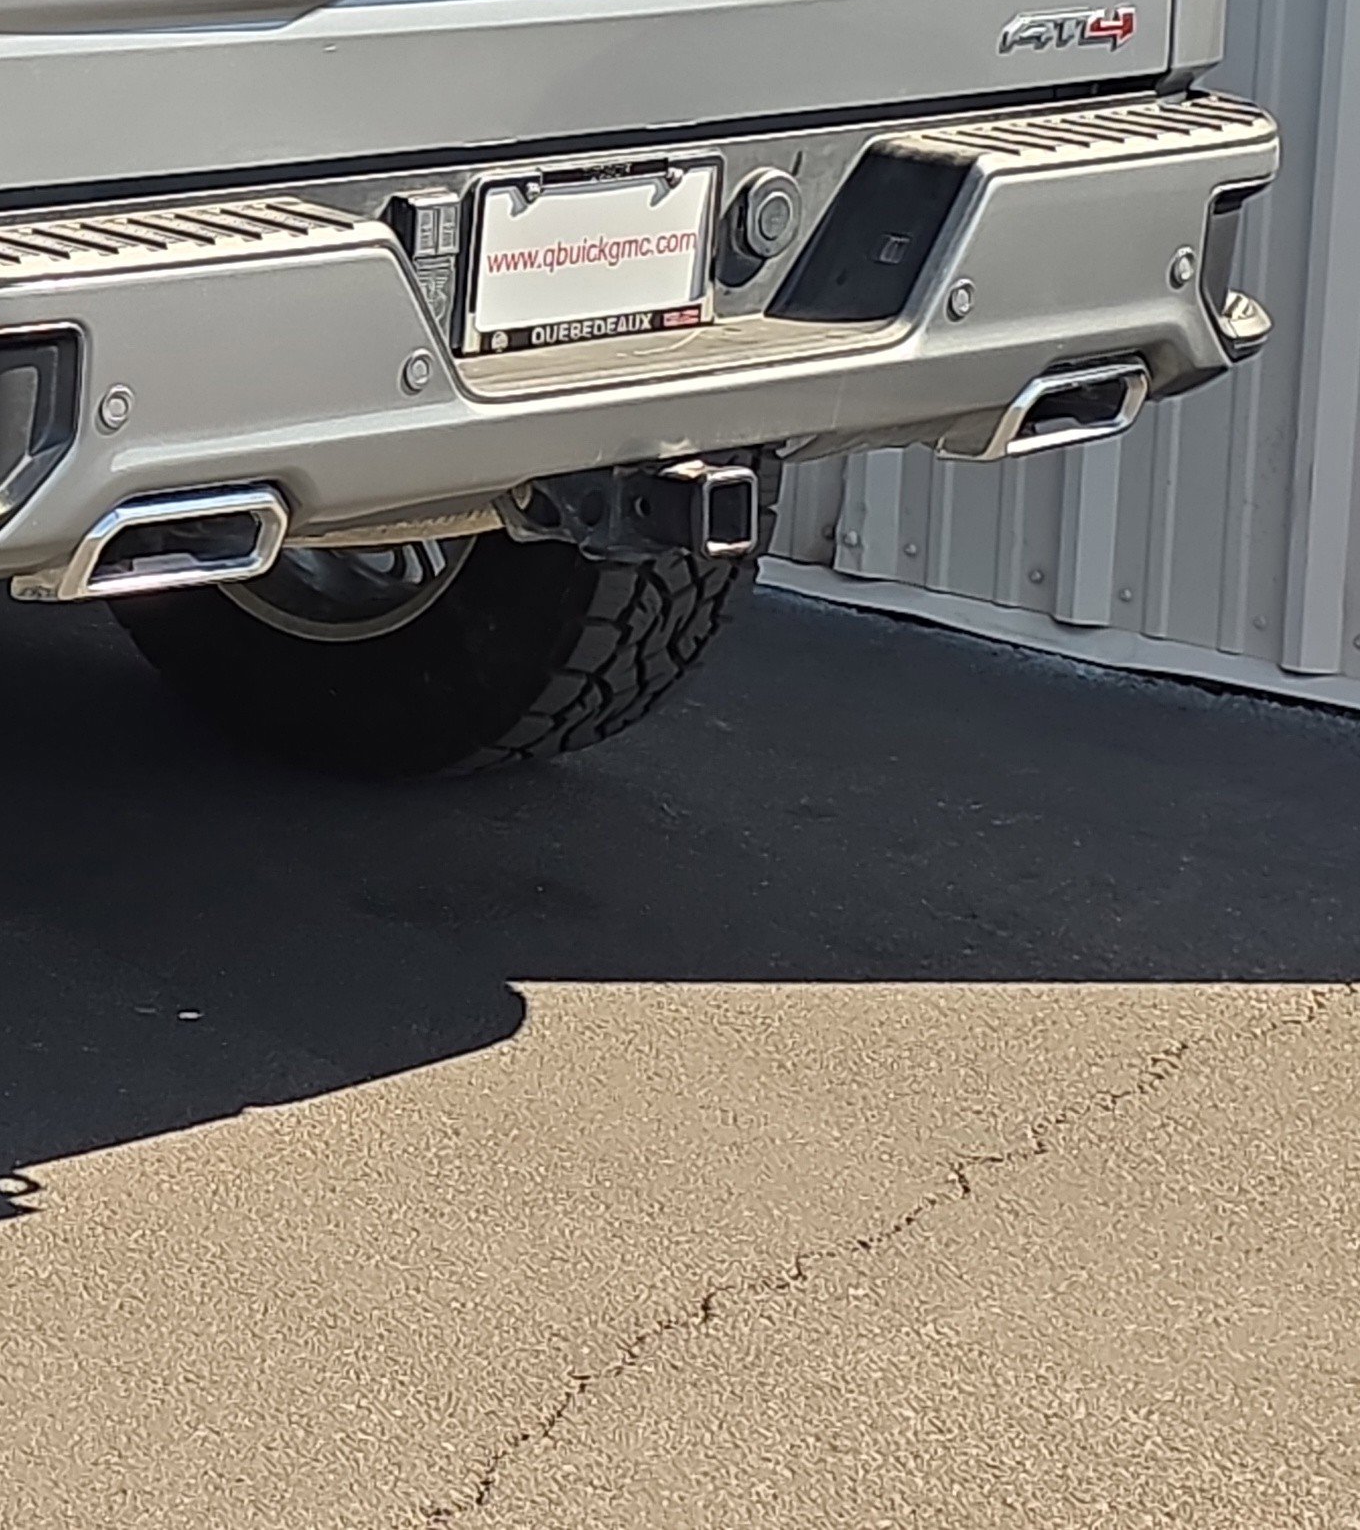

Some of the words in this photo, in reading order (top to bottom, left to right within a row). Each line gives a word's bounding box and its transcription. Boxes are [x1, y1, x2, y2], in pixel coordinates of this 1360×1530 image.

[998, 4, 1136, 53] AT4
[487, 232, 698, 273] www.qbuickgmc.com
[531, 312, 653, 346] QUEBEDEAUX
